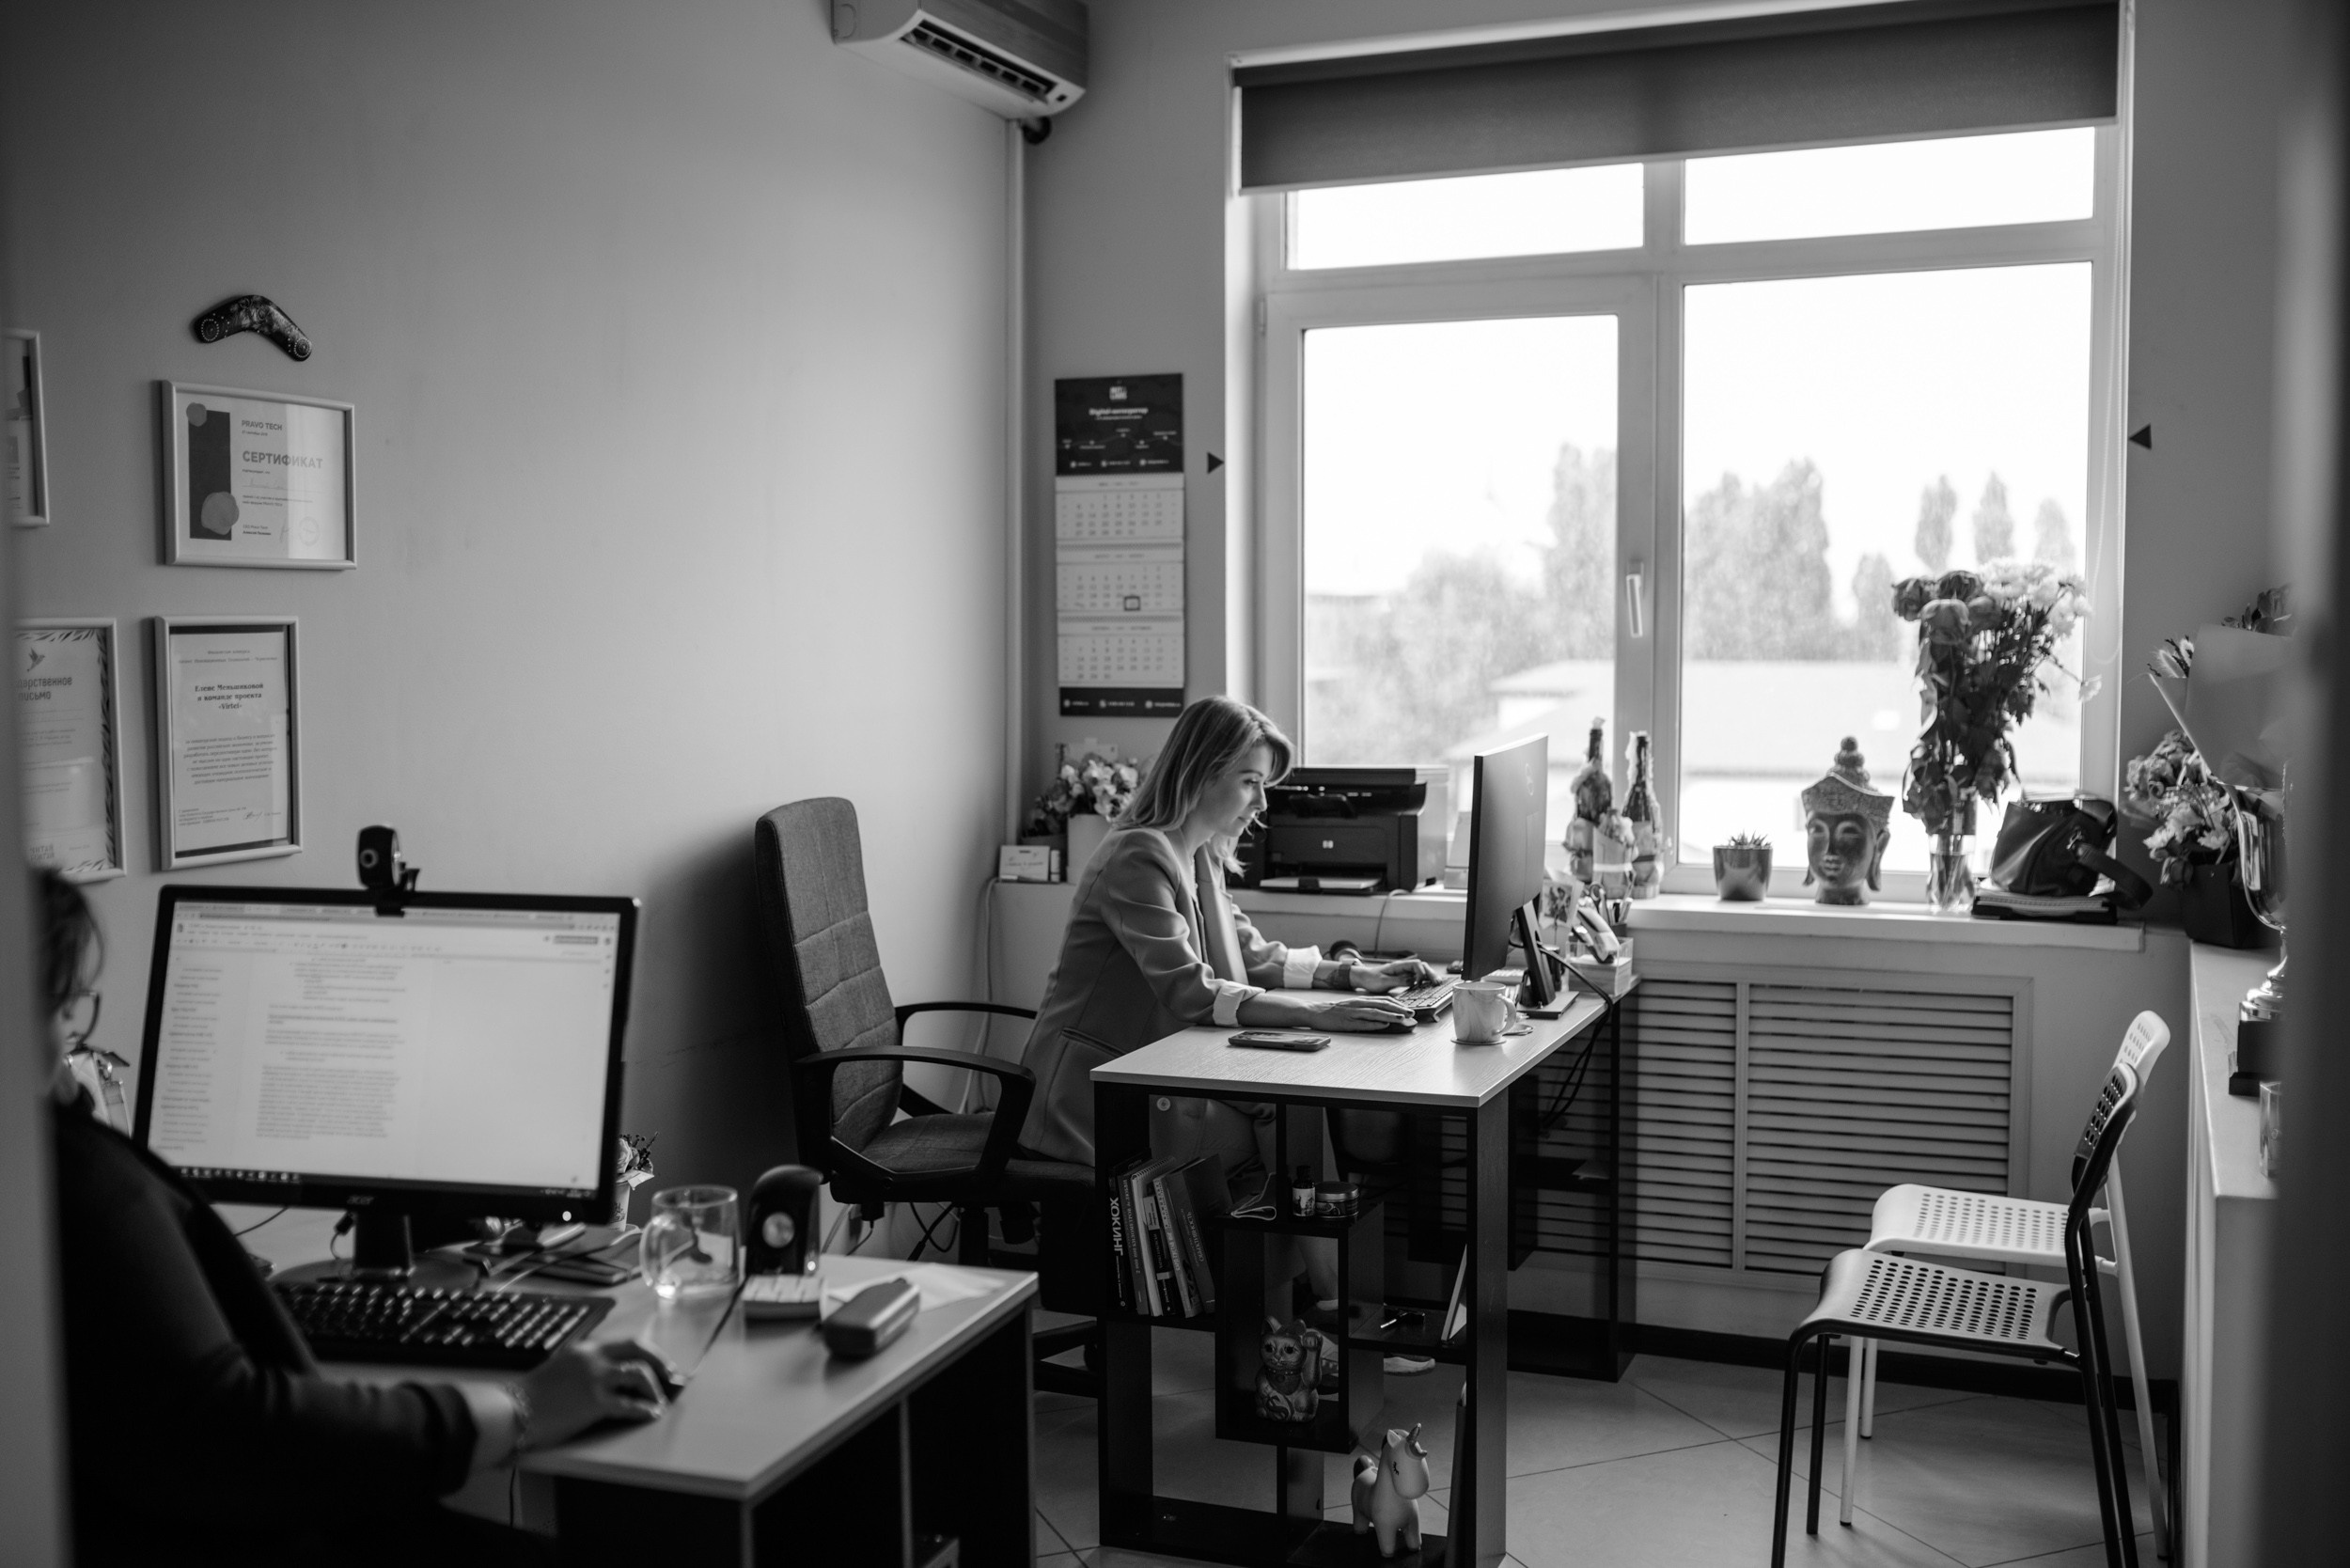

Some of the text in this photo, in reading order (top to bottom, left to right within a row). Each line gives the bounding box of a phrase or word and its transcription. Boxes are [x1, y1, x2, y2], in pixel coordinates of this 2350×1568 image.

[242, 419, 283, 431] PRAVO TECH
[243, 450, 323, 469] СЕРТИФИКАТ
[19, 677, 72, 690] дарственное
[1109, 1197, 1123, 1256] ХОКИНГ
